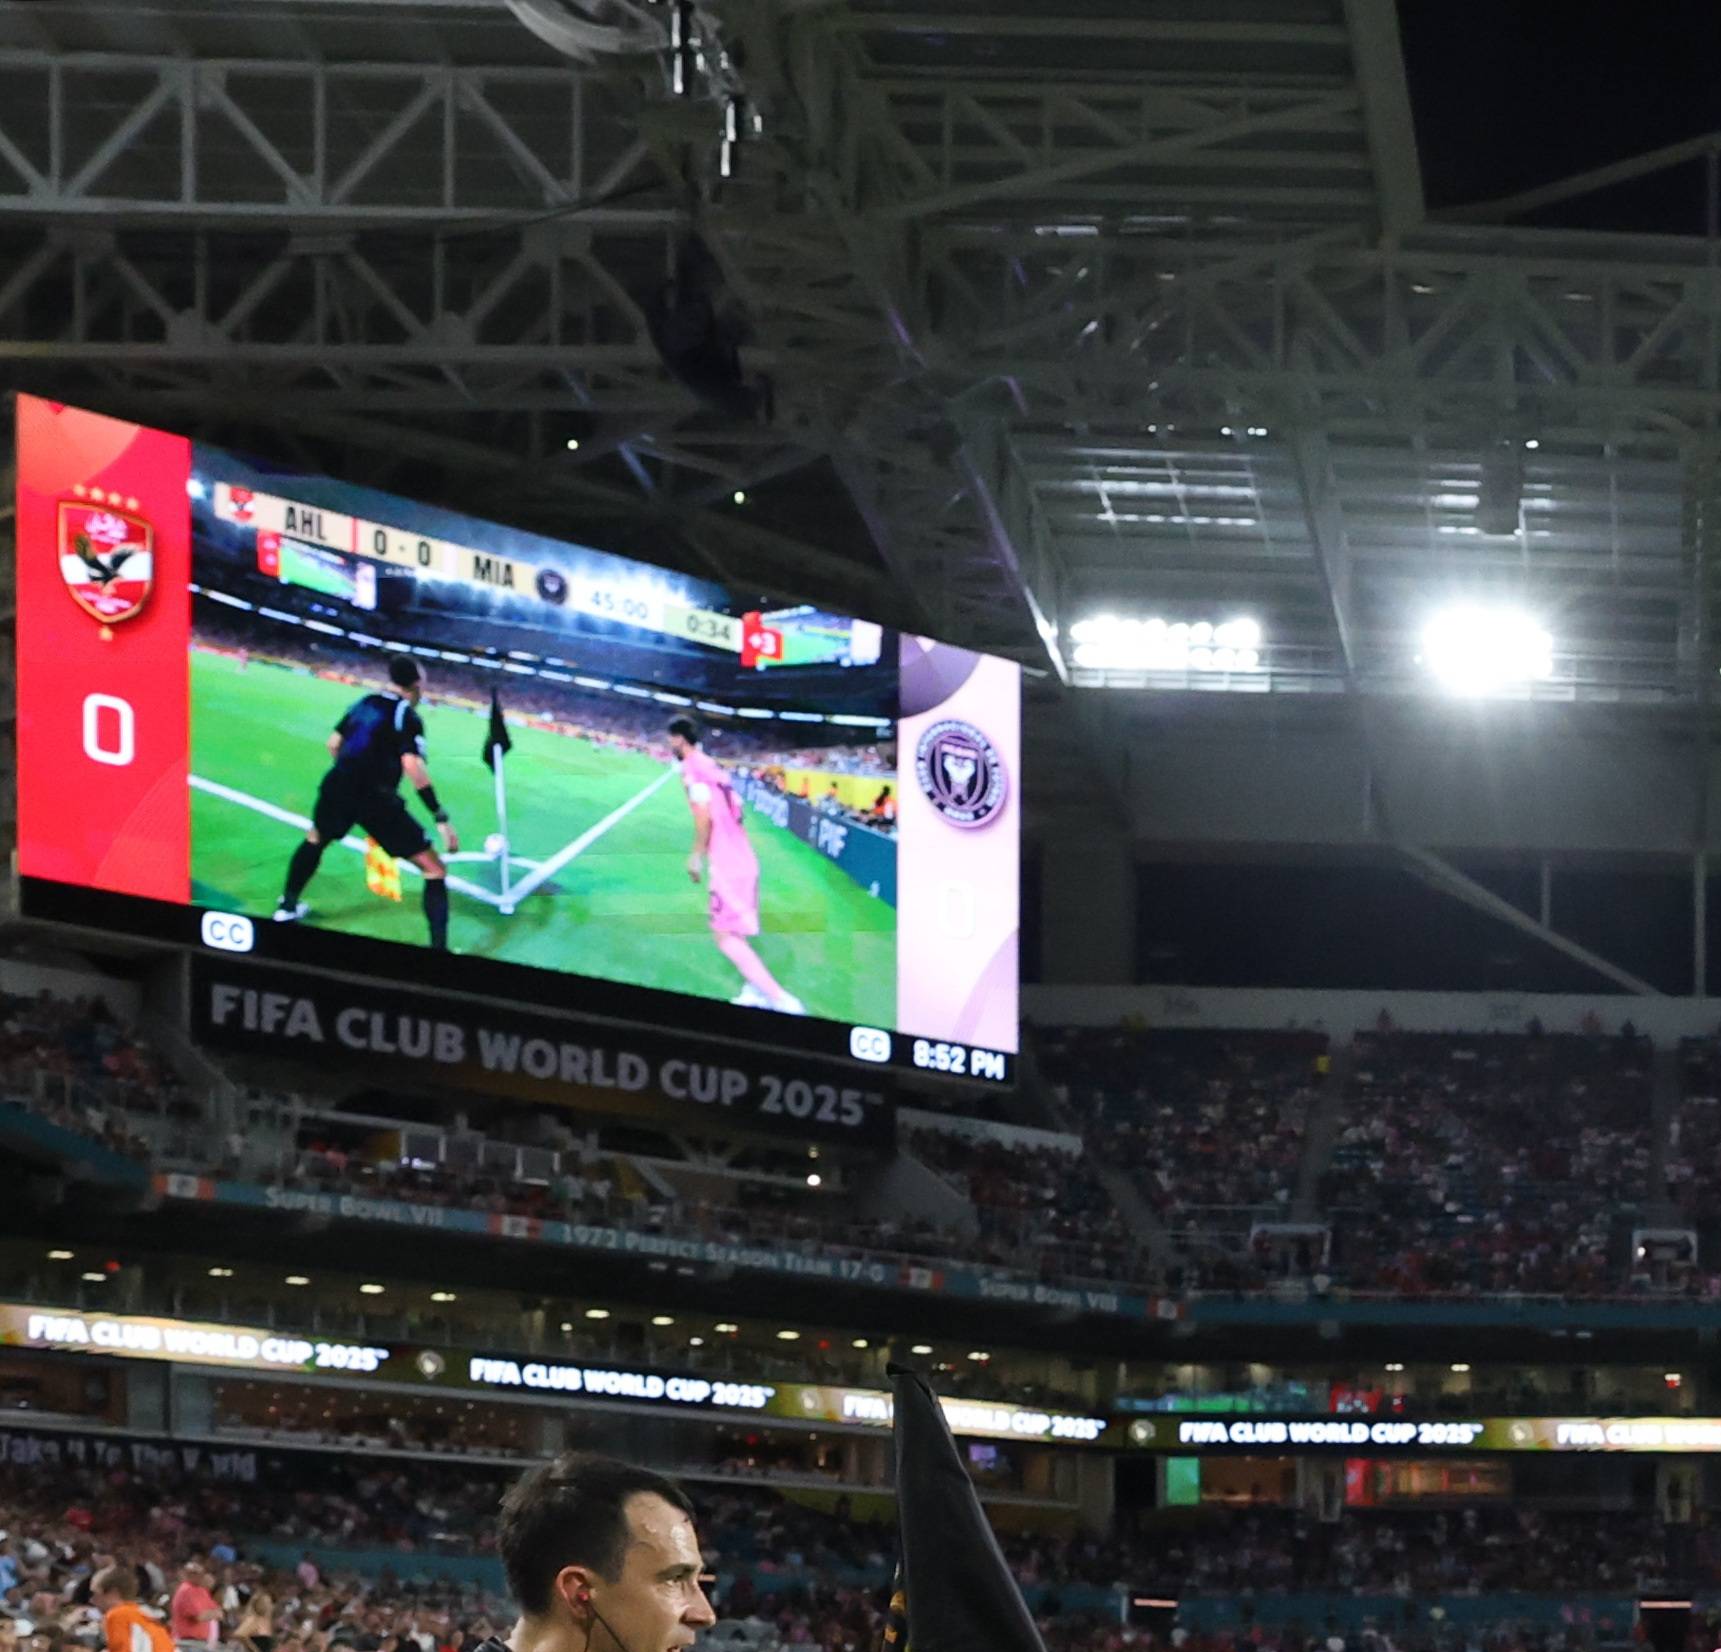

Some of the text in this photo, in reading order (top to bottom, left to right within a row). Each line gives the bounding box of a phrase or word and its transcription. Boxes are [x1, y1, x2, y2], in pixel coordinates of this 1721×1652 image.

[285, 506, 327, 541] AHL
[374, 529, 388, 556] 0
[417, 541, 431, 567] 0
[473, 554, 516, 588] MIA
[83, 693, 136, 766] 0
[209, 918, 245, 947] CC
[211, 983, 325, 1043] FIFA
[335, 1006, 465, 1064] CLUB
[478, 1028, 649, 1092] WORLD
[659, 1058, 750, 1106] CUP
[856, 1034, 885, 1057] CC
[912, 1038, 1007, 1081] 8:52 PM
[28, 1314, 91, 1343] FIFA
[91, 1321, 162, 1351] CLUB
[164, 1327, 260, 1359] WORLD
[260, 1338, 314, 1364] CUP
[470, 1359, 521, 1384] FIFA
[522, 1364, 582, 1390] CLUB
[583, 1370, 664, 1397] WORLD
[665, 1378, 711, 1401] CUP
[1011, 1412, 1051, 1434] CUP
[1179, 1423, 1228, 1442] FIFA
[1229, 1423, 1288, 1442] CLUB
[1289, 1423, 1370, 1442] WORLD
[1371, 1423, 1417, 1443] CUP
[182, 1446, 256, 1481] Wrld
